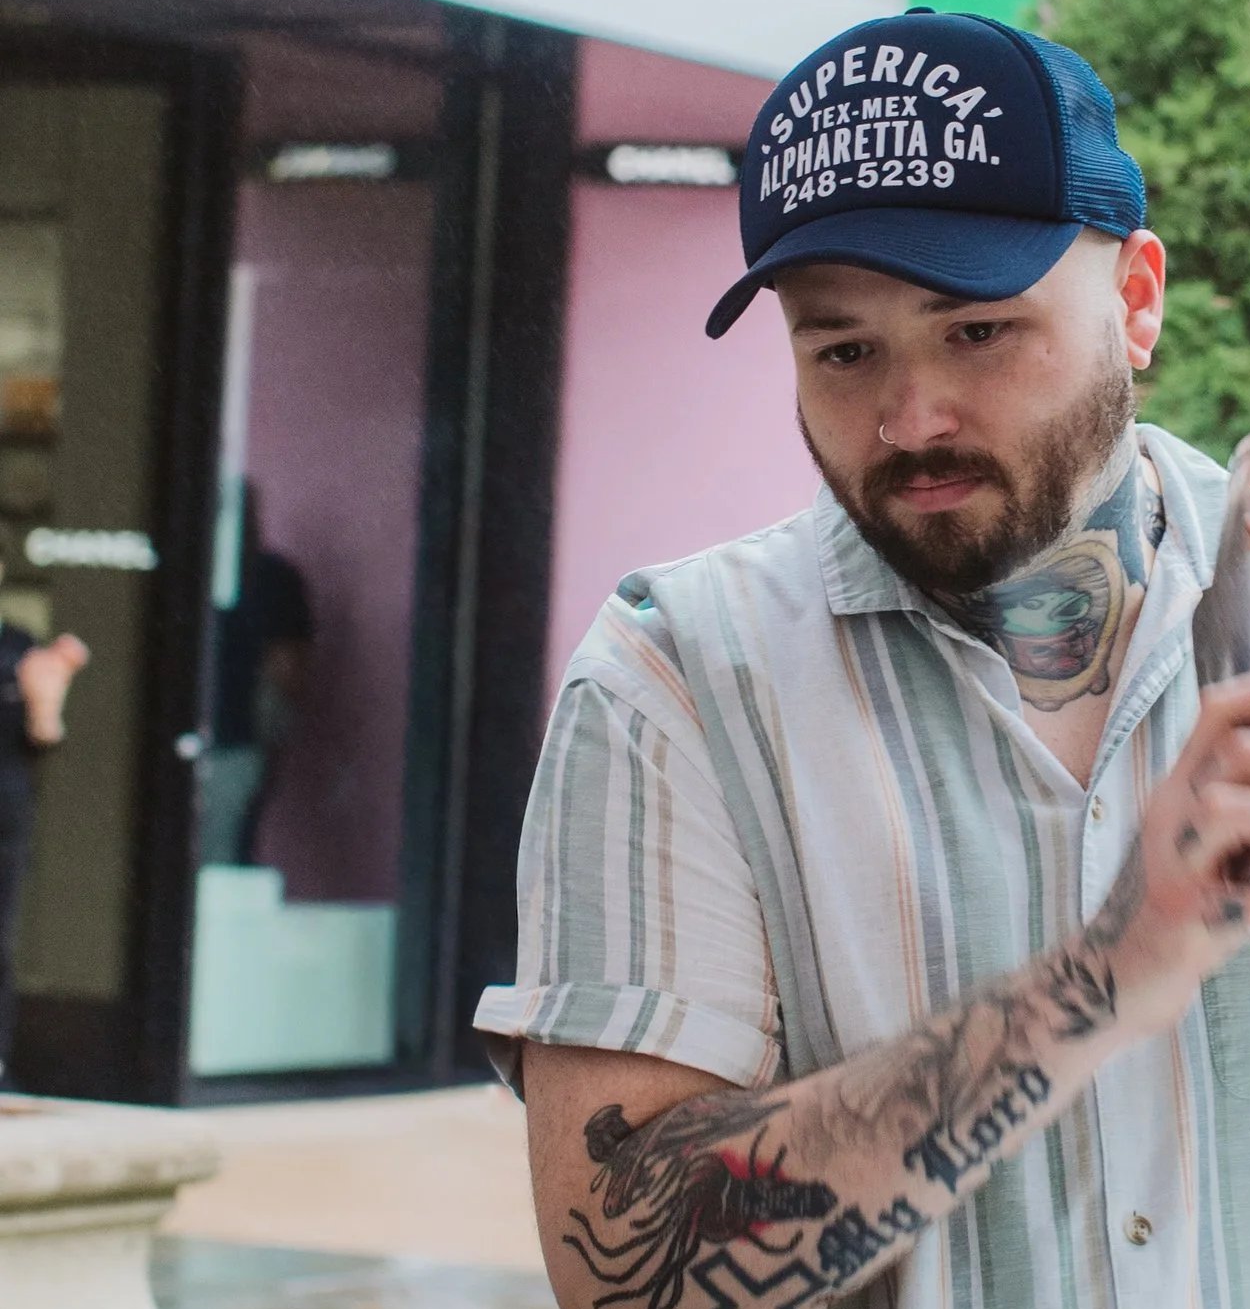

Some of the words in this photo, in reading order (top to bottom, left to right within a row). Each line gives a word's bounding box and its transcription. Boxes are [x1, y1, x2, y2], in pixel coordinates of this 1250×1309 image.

[811, 95, 918, 132] TEX-MEX
[760, 120, 928, 202] ALPHARETTA
[944, 121, 1000, 166] GA.
[782, 159, 955, 214] 248-5239
